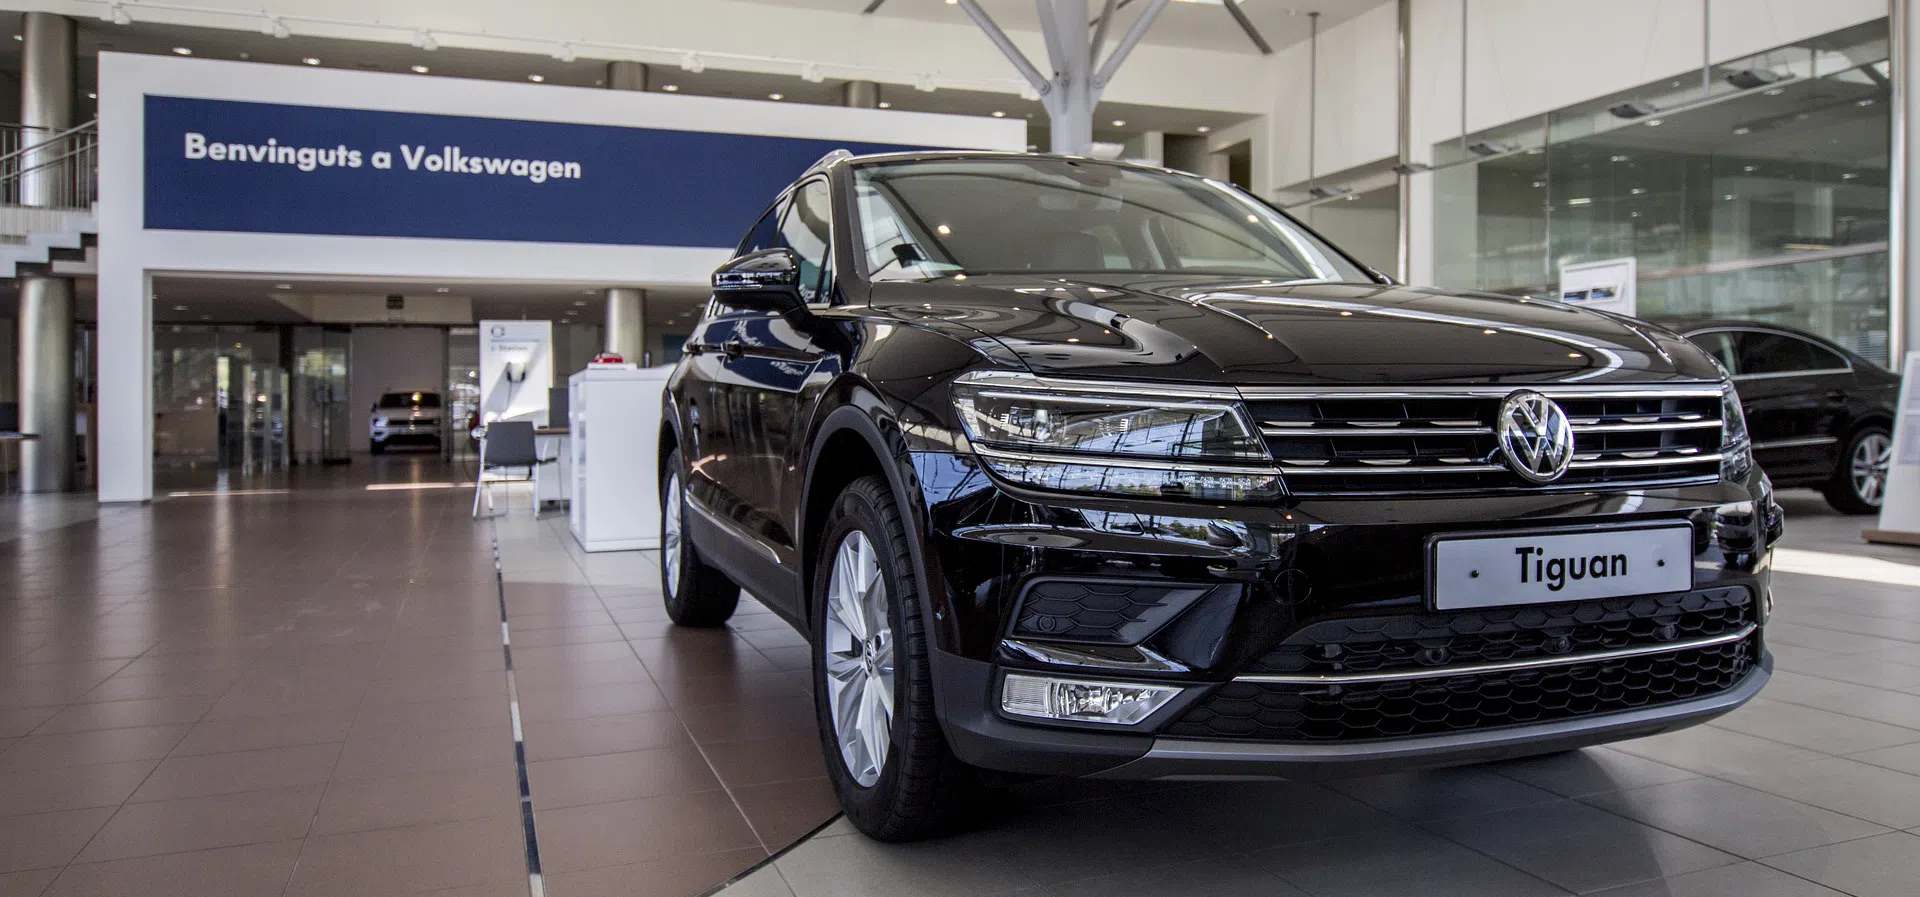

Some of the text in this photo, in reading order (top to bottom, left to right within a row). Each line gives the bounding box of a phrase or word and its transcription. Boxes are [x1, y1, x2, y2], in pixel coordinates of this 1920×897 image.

[184, 132, 581, 183] Benvinguts a Volkswagen
[1515, 546, 1627, 592] Tiguan
